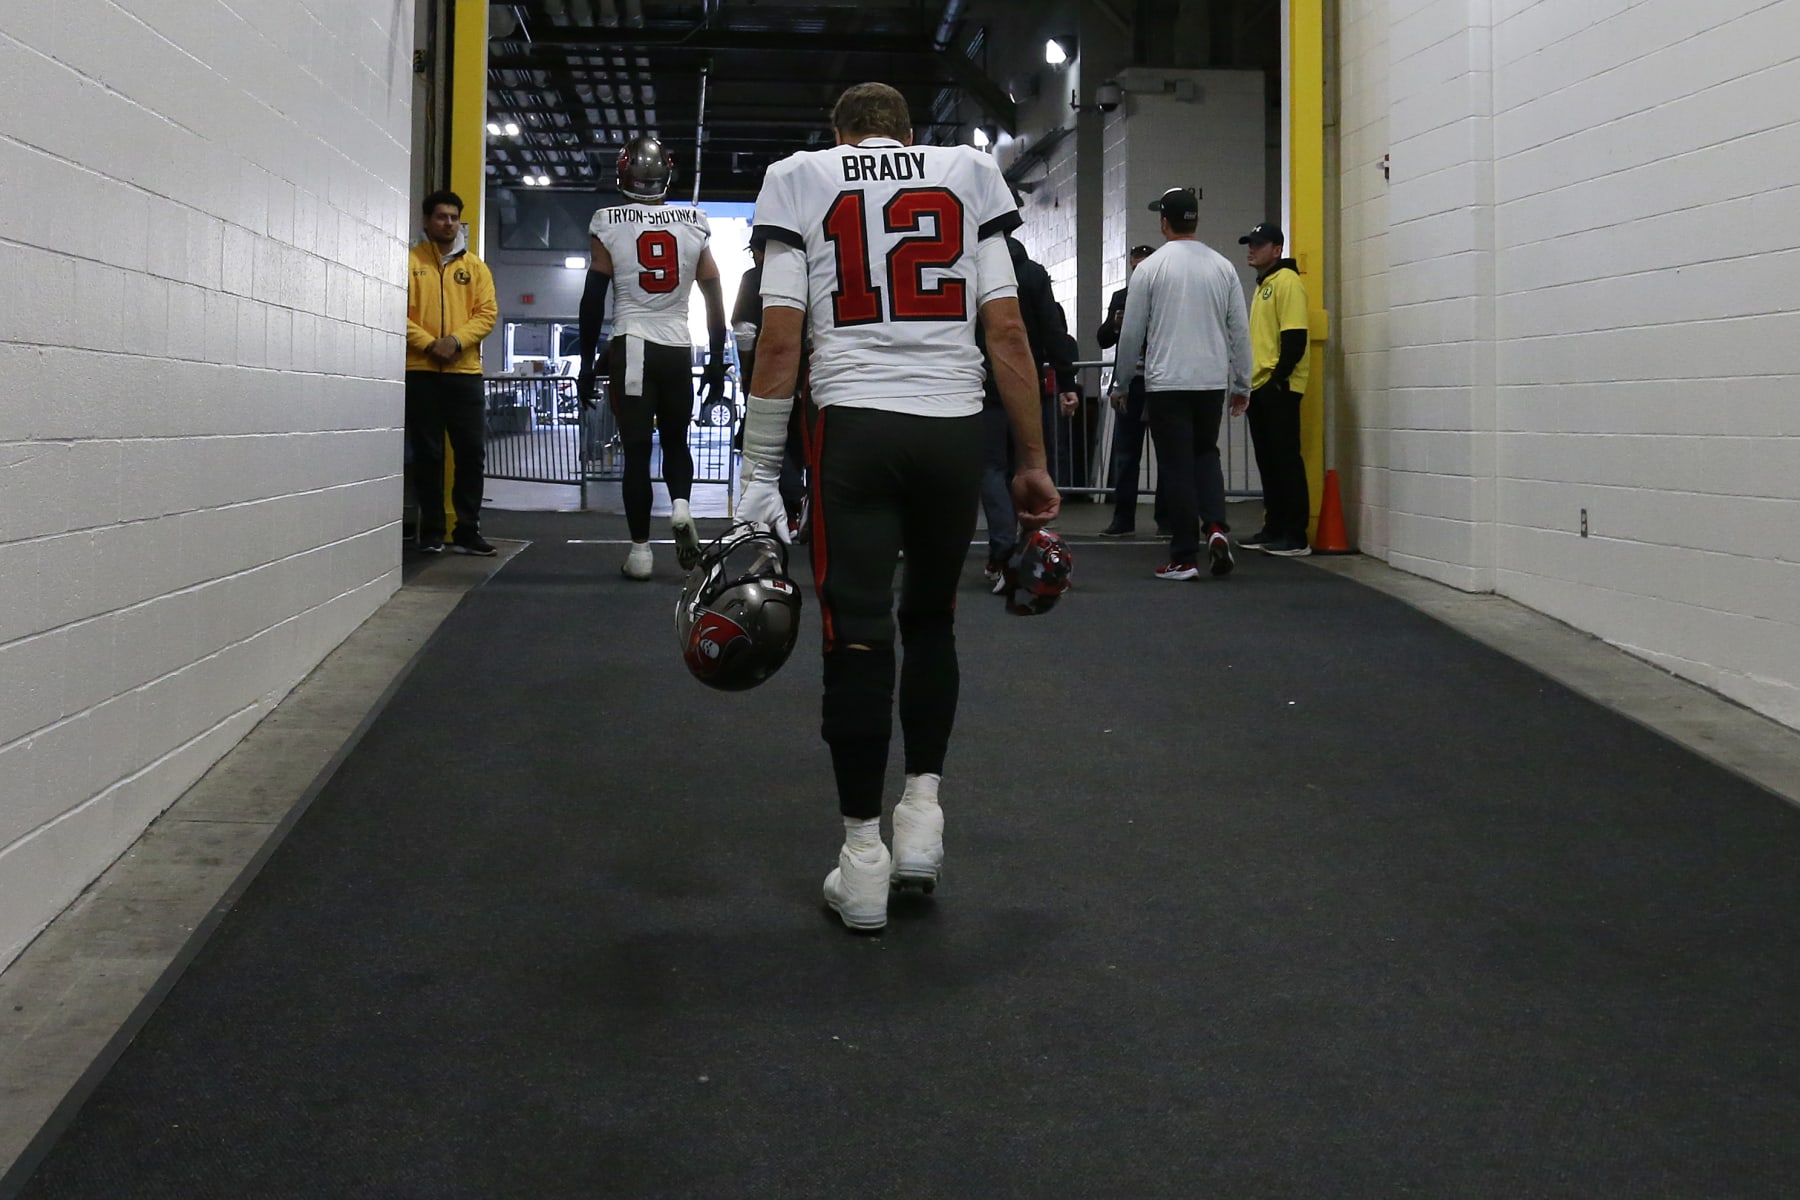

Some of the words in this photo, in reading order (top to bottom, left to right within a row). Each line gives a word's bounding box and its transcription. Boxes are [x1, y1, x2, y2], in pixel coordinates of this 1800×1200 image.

[842, 152, 926, 181] BRADY
[607, 208, 699, 225] TRYON-SHOYINKA
[636, 229, 680, 294] 9
[823, 186, 968, 328] 12
